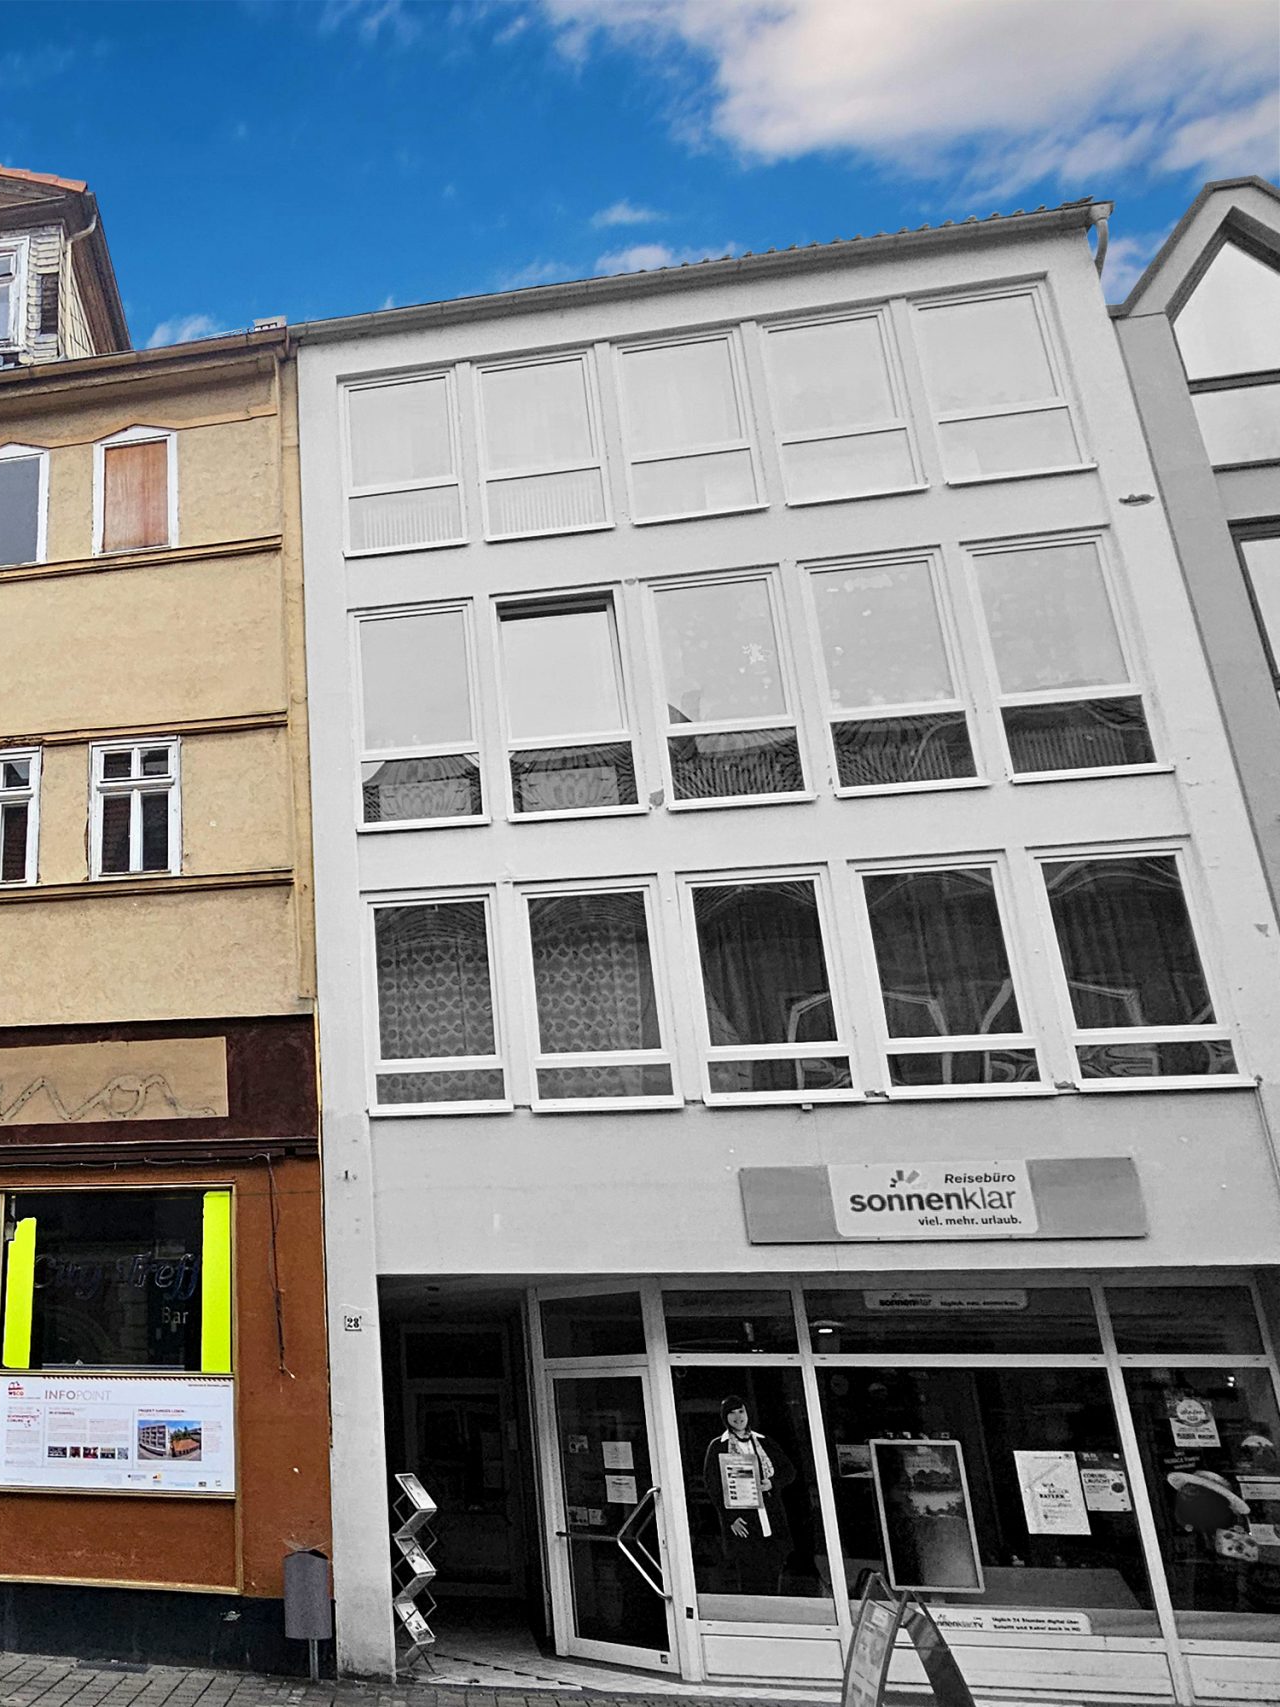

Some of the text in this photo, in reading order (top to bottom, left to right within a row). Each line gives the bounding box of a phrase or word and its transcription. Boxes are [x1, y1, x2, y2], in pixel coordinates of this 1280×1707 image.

[944, 1173, 1016, 1184] Reisebüro
[849, 1187, 1016, 1212] sonnenklar
[918, 1214, 1022, 1226] viel. mehr. urlaub.
[162, 1306, 189, 1325] Bar
[347, 1317, 360, 1328] 28
[44, 1390, 112, 1401] INFOPOINT
